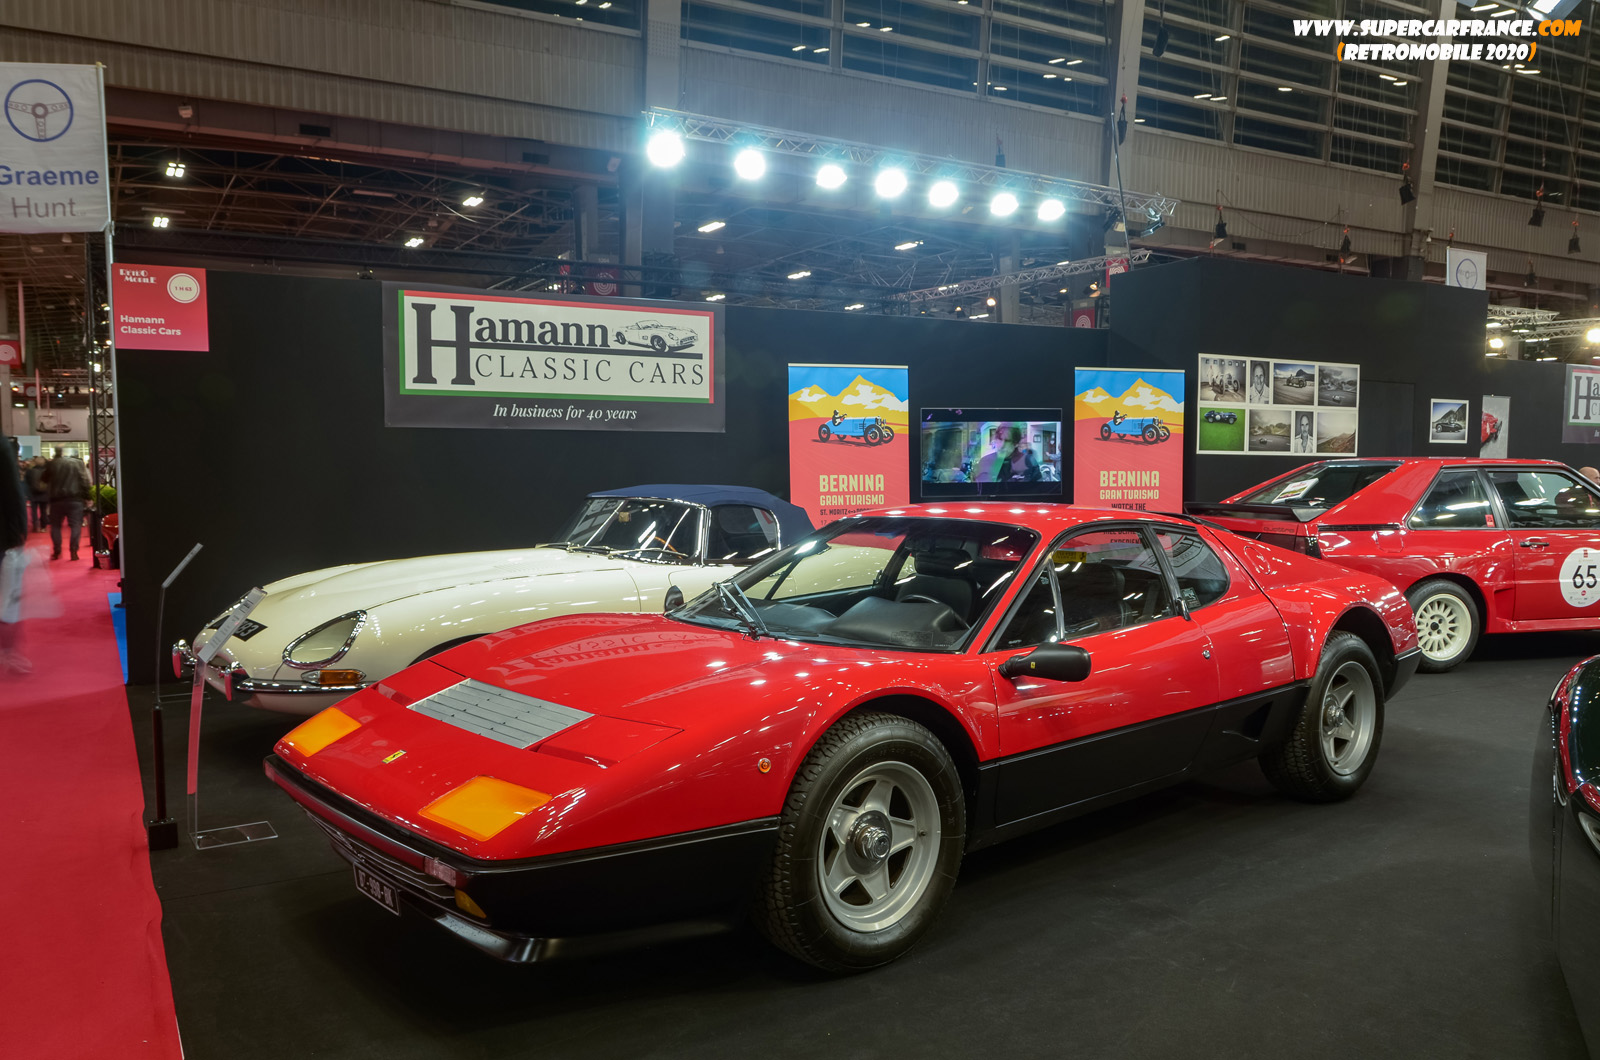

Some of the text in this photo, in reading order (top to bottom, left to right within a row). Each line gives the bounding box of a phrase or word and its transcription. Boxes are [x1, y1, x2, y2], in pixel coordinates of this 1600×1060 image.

[0, 165, 100, 186] Graeme
[11, 197, 77, 218] Hunt
[120, 315, 165, 324] Hamann
[120, 326, 182, 336] Classic Cars
[411, 302, 611, 386] Hamann
[475, 353, 704, 386] CLASSIC CARS
[493, 403, 638, 421] In business for 40 years
[819, 474, 885, 492] BERNINA
[1100, 470, 1160, 487] BERNINA
[820, 494, 885, 506] GRAN TURISMO
[1100, 489, 1160, 500] GRAN TURISMO
[829, 508, 848, 516] MORITZ
[1572, 565, 1598, 589] 65
